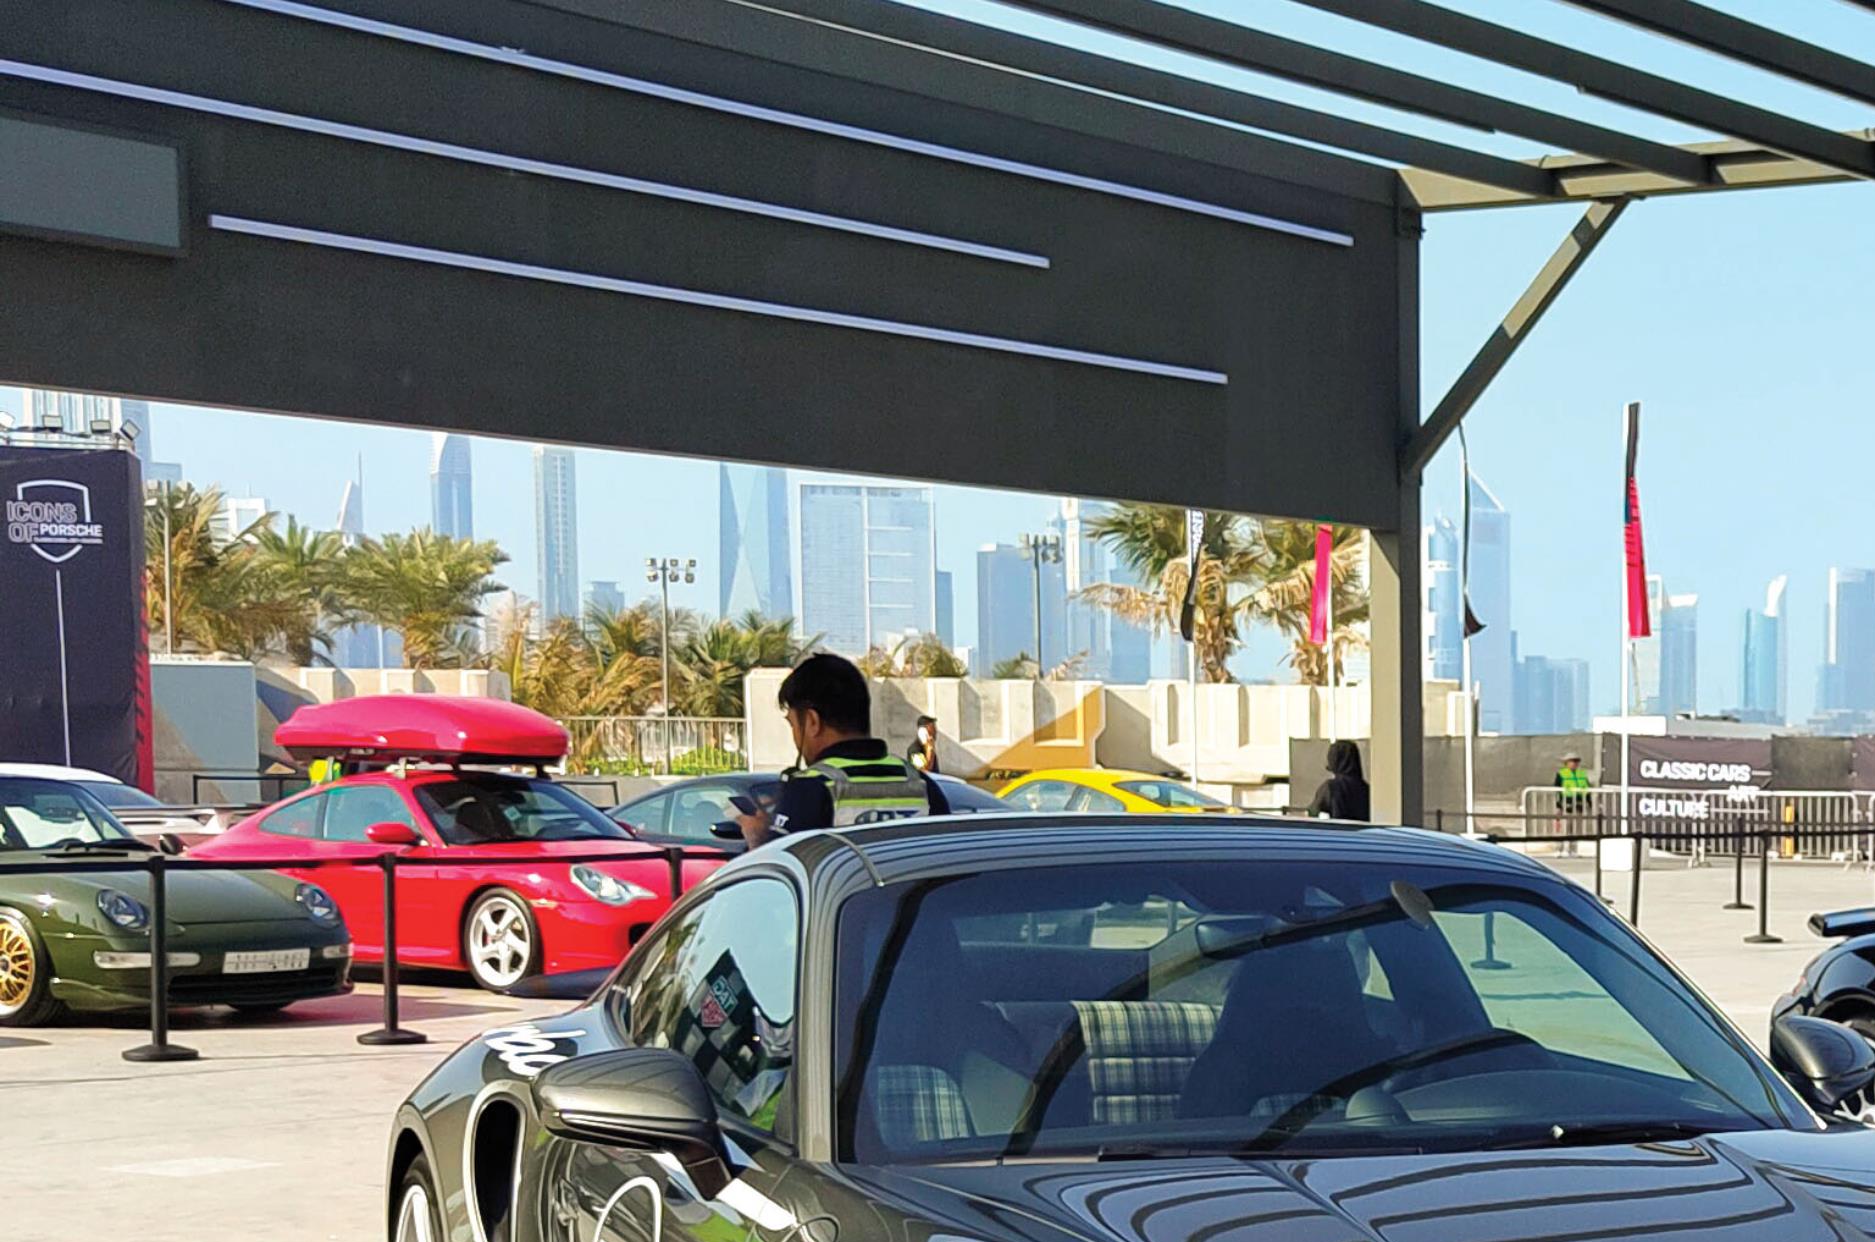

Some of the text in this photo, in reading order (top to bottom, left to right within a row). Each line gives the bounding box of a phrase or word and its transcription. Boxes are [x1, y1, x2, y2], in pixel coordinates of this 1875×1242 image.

[6, 500, 78, 523] ICONS
[8, 522, 39, 543] OF
[40, 523, 103, 537] PORSCHE
[1640, 759, 1751, 783] CLASSIC CARS
[1639, 797, 1709, 819] CULTURE
